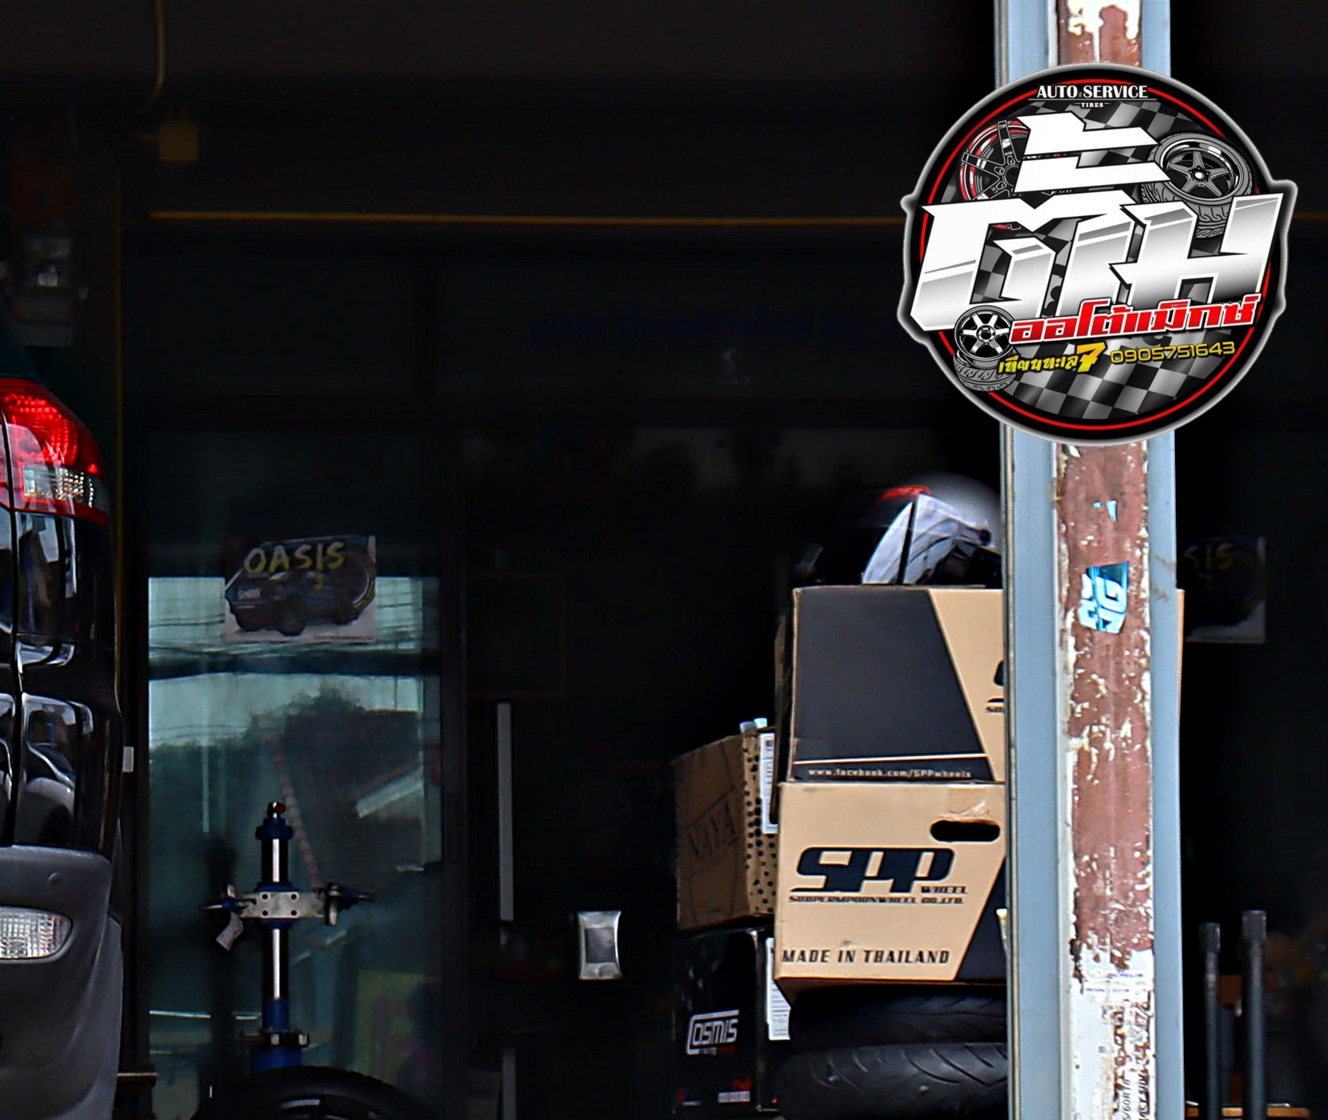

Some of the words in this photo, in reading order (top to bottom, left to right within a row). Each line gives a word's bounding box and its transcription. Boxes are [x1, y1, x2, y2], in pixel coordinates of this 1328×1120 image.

[244, 541, 346, 574] OASIS
[807, 767, 972, 780] www.facebook.com/SPPwheels
[790, 846, 956, 894] SPP
[920, 885, 968, 895] WHEEL
[781, 949, 830, 964] MADE
[837, 949, 854, 964] IN
[863, 949, 951, 965] THAILAND
